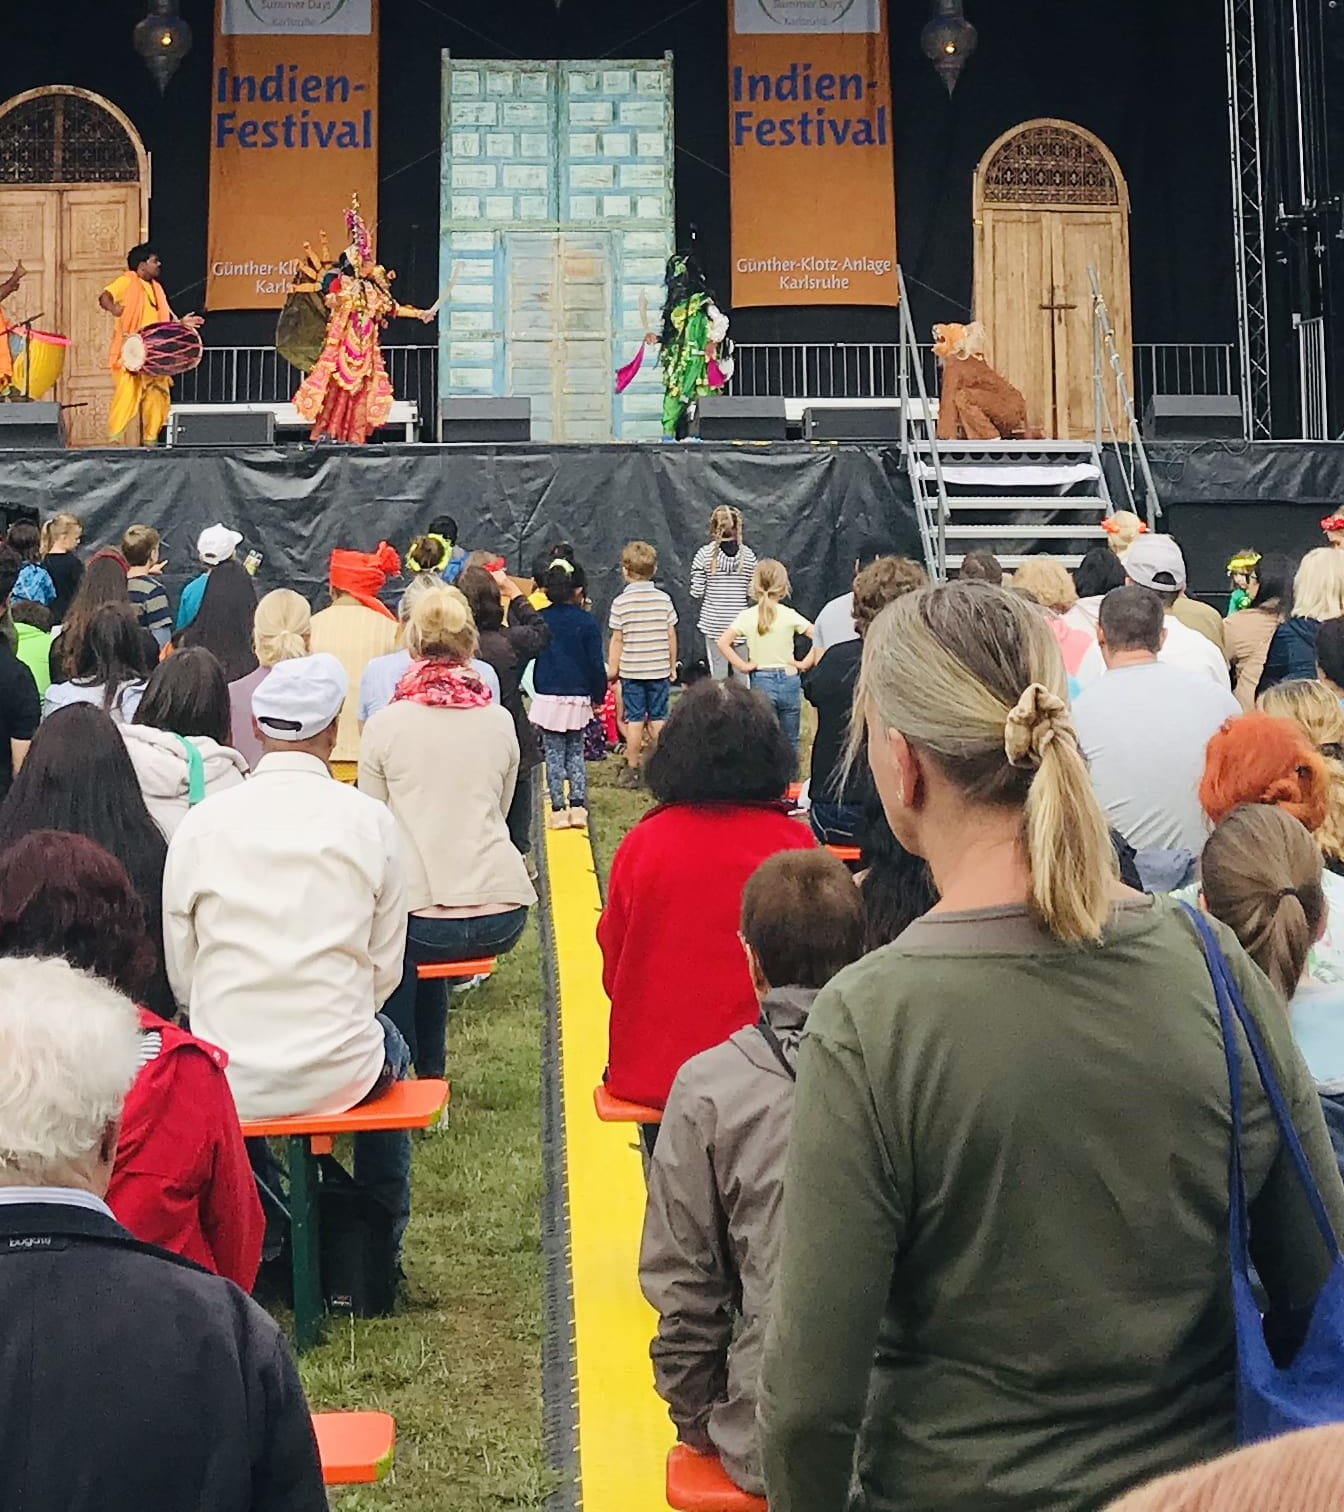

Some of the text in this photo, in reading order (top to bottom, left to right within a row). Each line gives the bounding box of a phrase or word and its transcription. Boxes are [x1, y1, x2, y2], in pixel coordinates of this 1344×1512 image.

[261, 0, 331, 11] Summer Days
[774, 0, 816, 9] Summer
[217, 65, 363, 103] Indien-
[734, 64, 876, 101] Indien-
[216, 110, 371, 148] Festival
[734, 108, 886, 146] Festival
[737, 256, 891, 275] Günther-Klotz-Anlage
[780, 275, 849, 289] Karlsruhe
